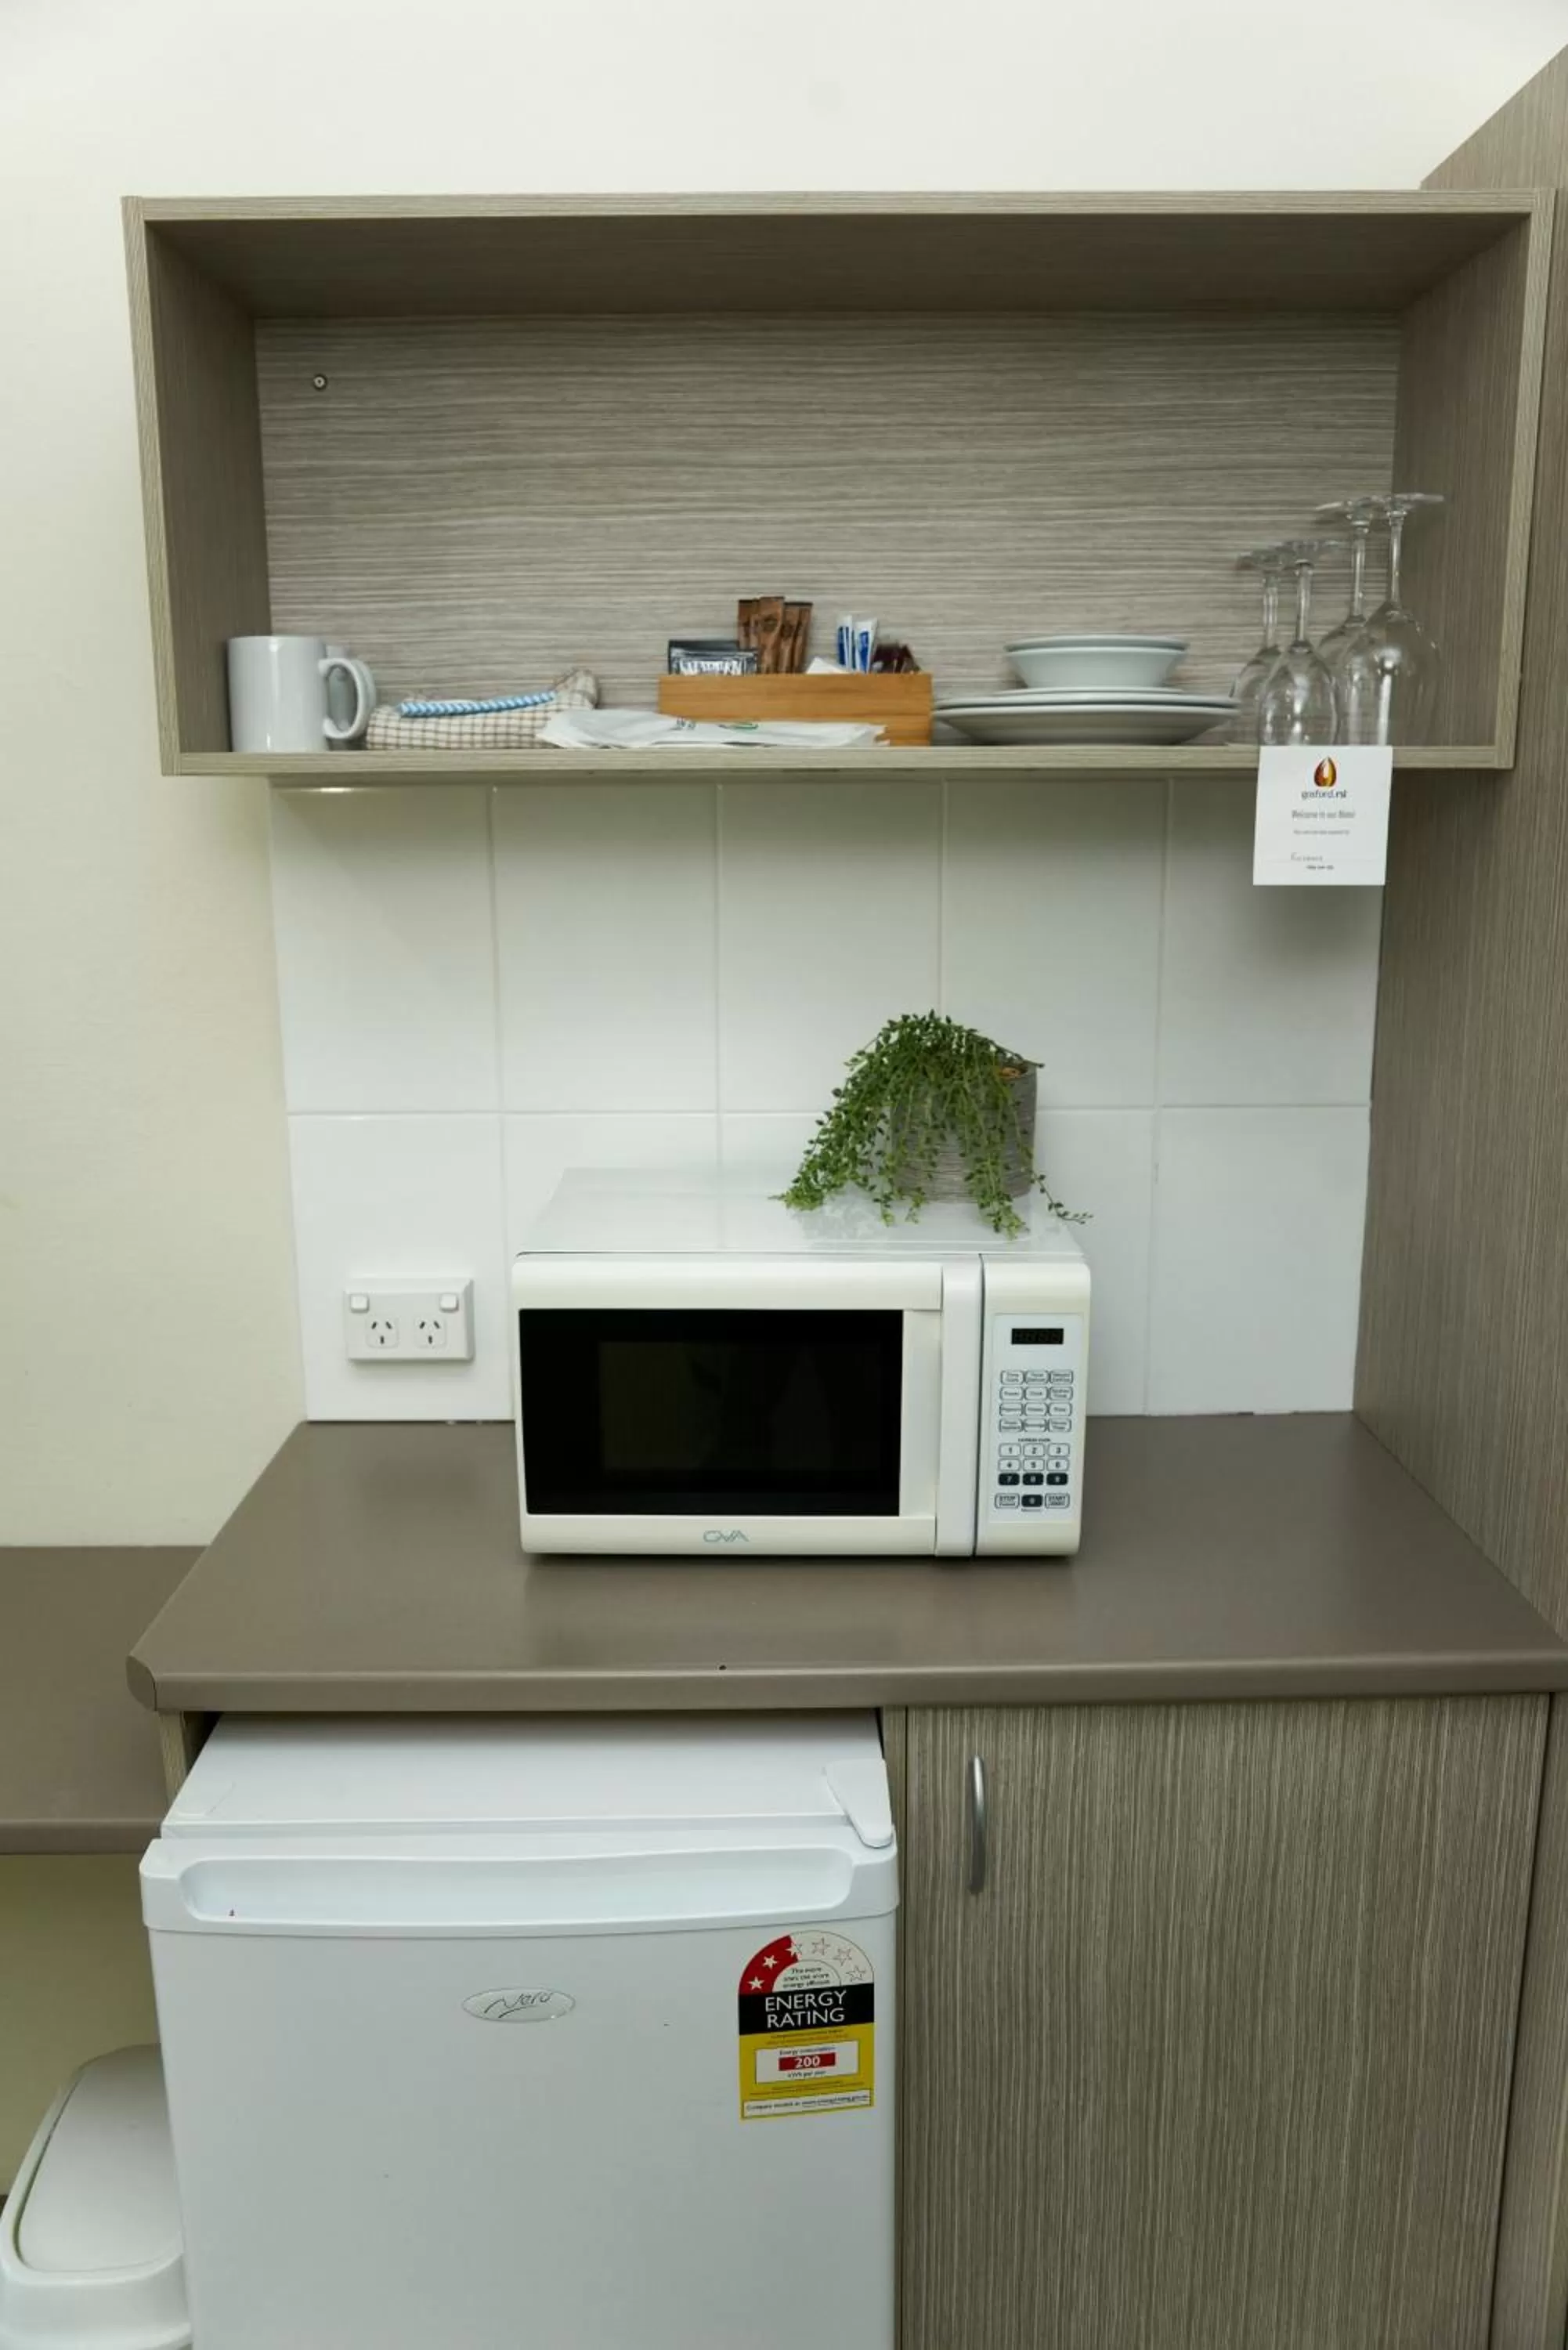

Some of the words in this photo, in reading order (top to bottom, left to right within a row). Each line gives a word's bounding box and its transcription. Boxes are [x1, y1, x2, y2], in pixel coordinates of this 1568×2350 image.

[764, 1990, 847, 2012] ENERGY
[767, 2008, 845, 2029] RATING
[794, 2055, 821, 2069] 200
